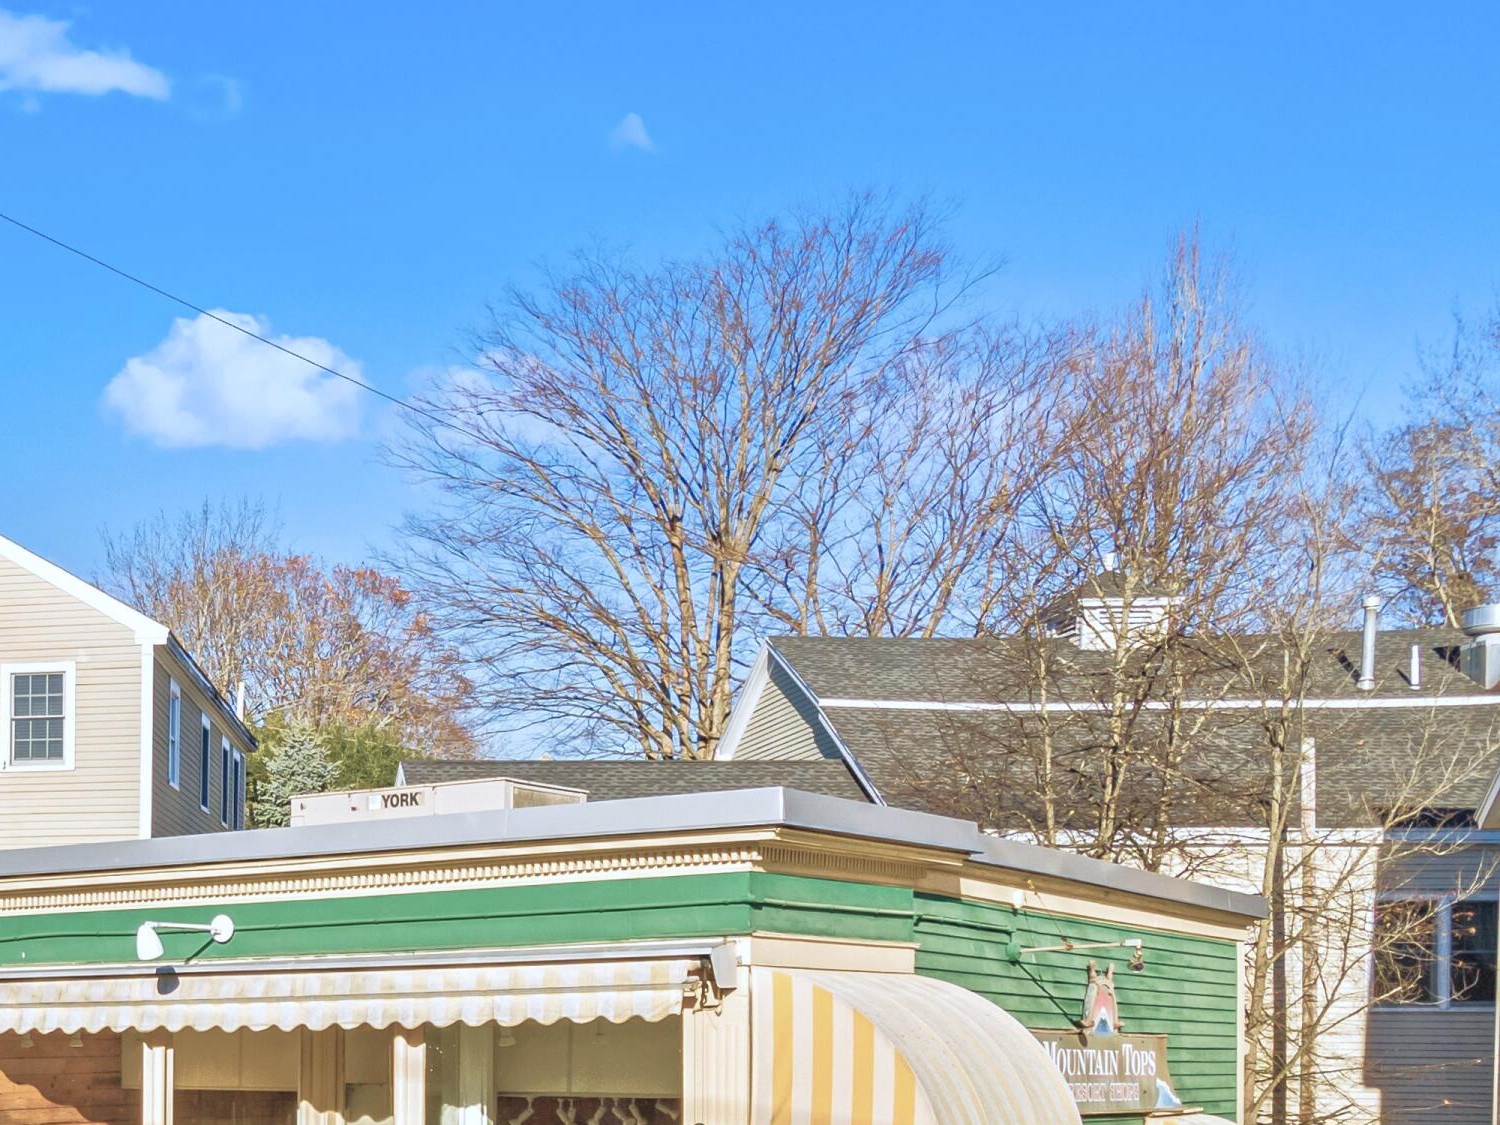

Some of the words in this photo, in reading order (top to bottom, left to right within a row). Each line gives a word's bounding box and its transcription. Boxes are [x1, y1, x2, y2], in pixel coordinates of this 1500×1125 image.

[381, 792, 419, 808] YORK
[1122, 1043, 1156, 1076] TOPS
[1109, 1082, 1140, 1102] SHOPS
